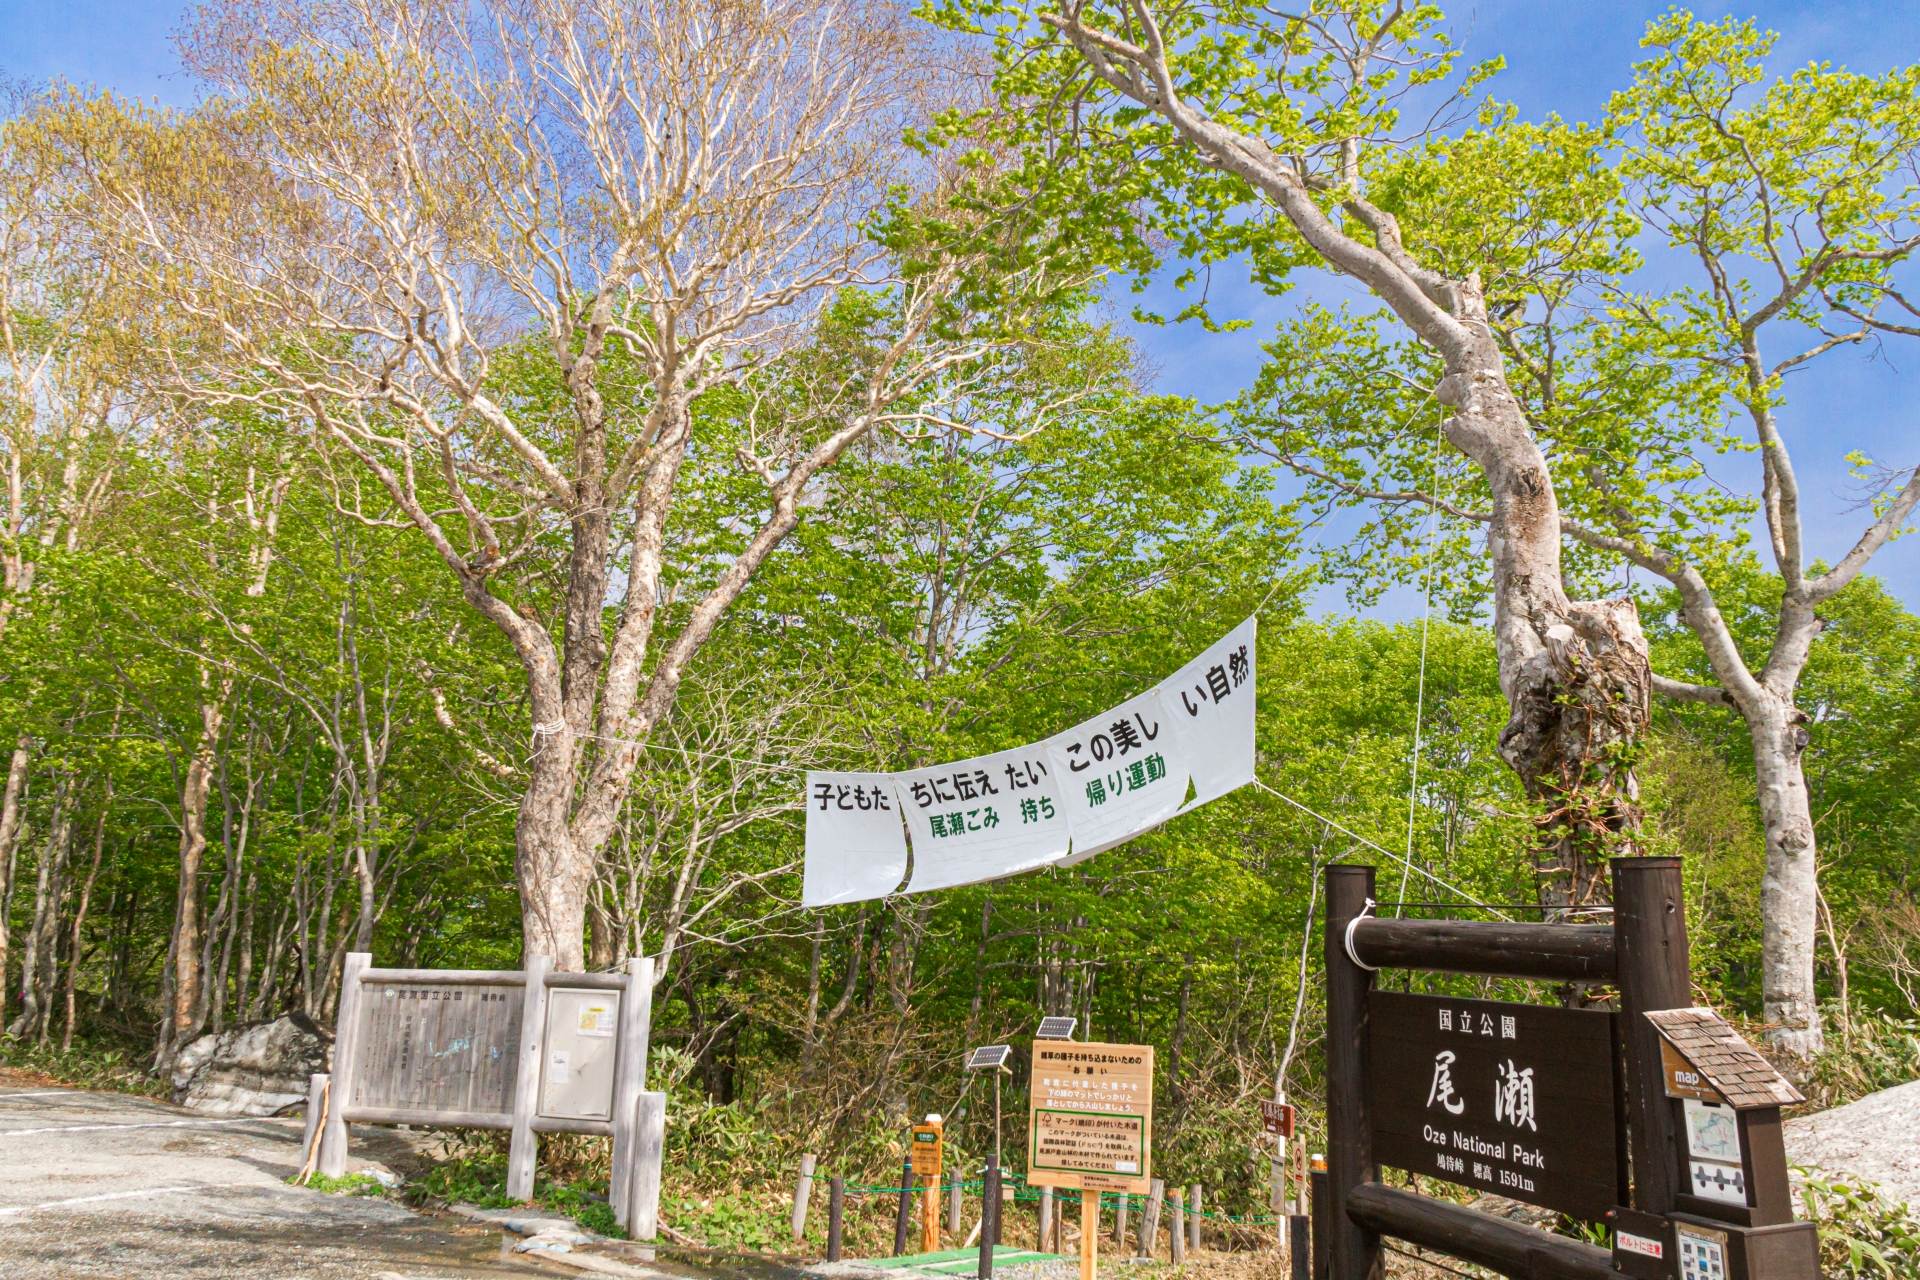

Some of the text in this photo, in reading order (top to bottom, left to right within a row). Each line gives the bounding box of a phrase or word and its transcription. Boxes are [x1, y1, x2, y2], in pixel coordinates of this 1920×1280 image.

[1439, 1009, 1516, 1039] 国立公園
[1041, 1051, 1142, 1064] 雑草の種子を持ち込まないための
[1426, 1050, 1537, 1132] 尾瀬
[1675, 1070, 1700, 1086] map
[1423, 1125, 1545, 1169] Oze National Park
[1437, 1153, 1535, 1192] 鳩待峠 標高 1591m
